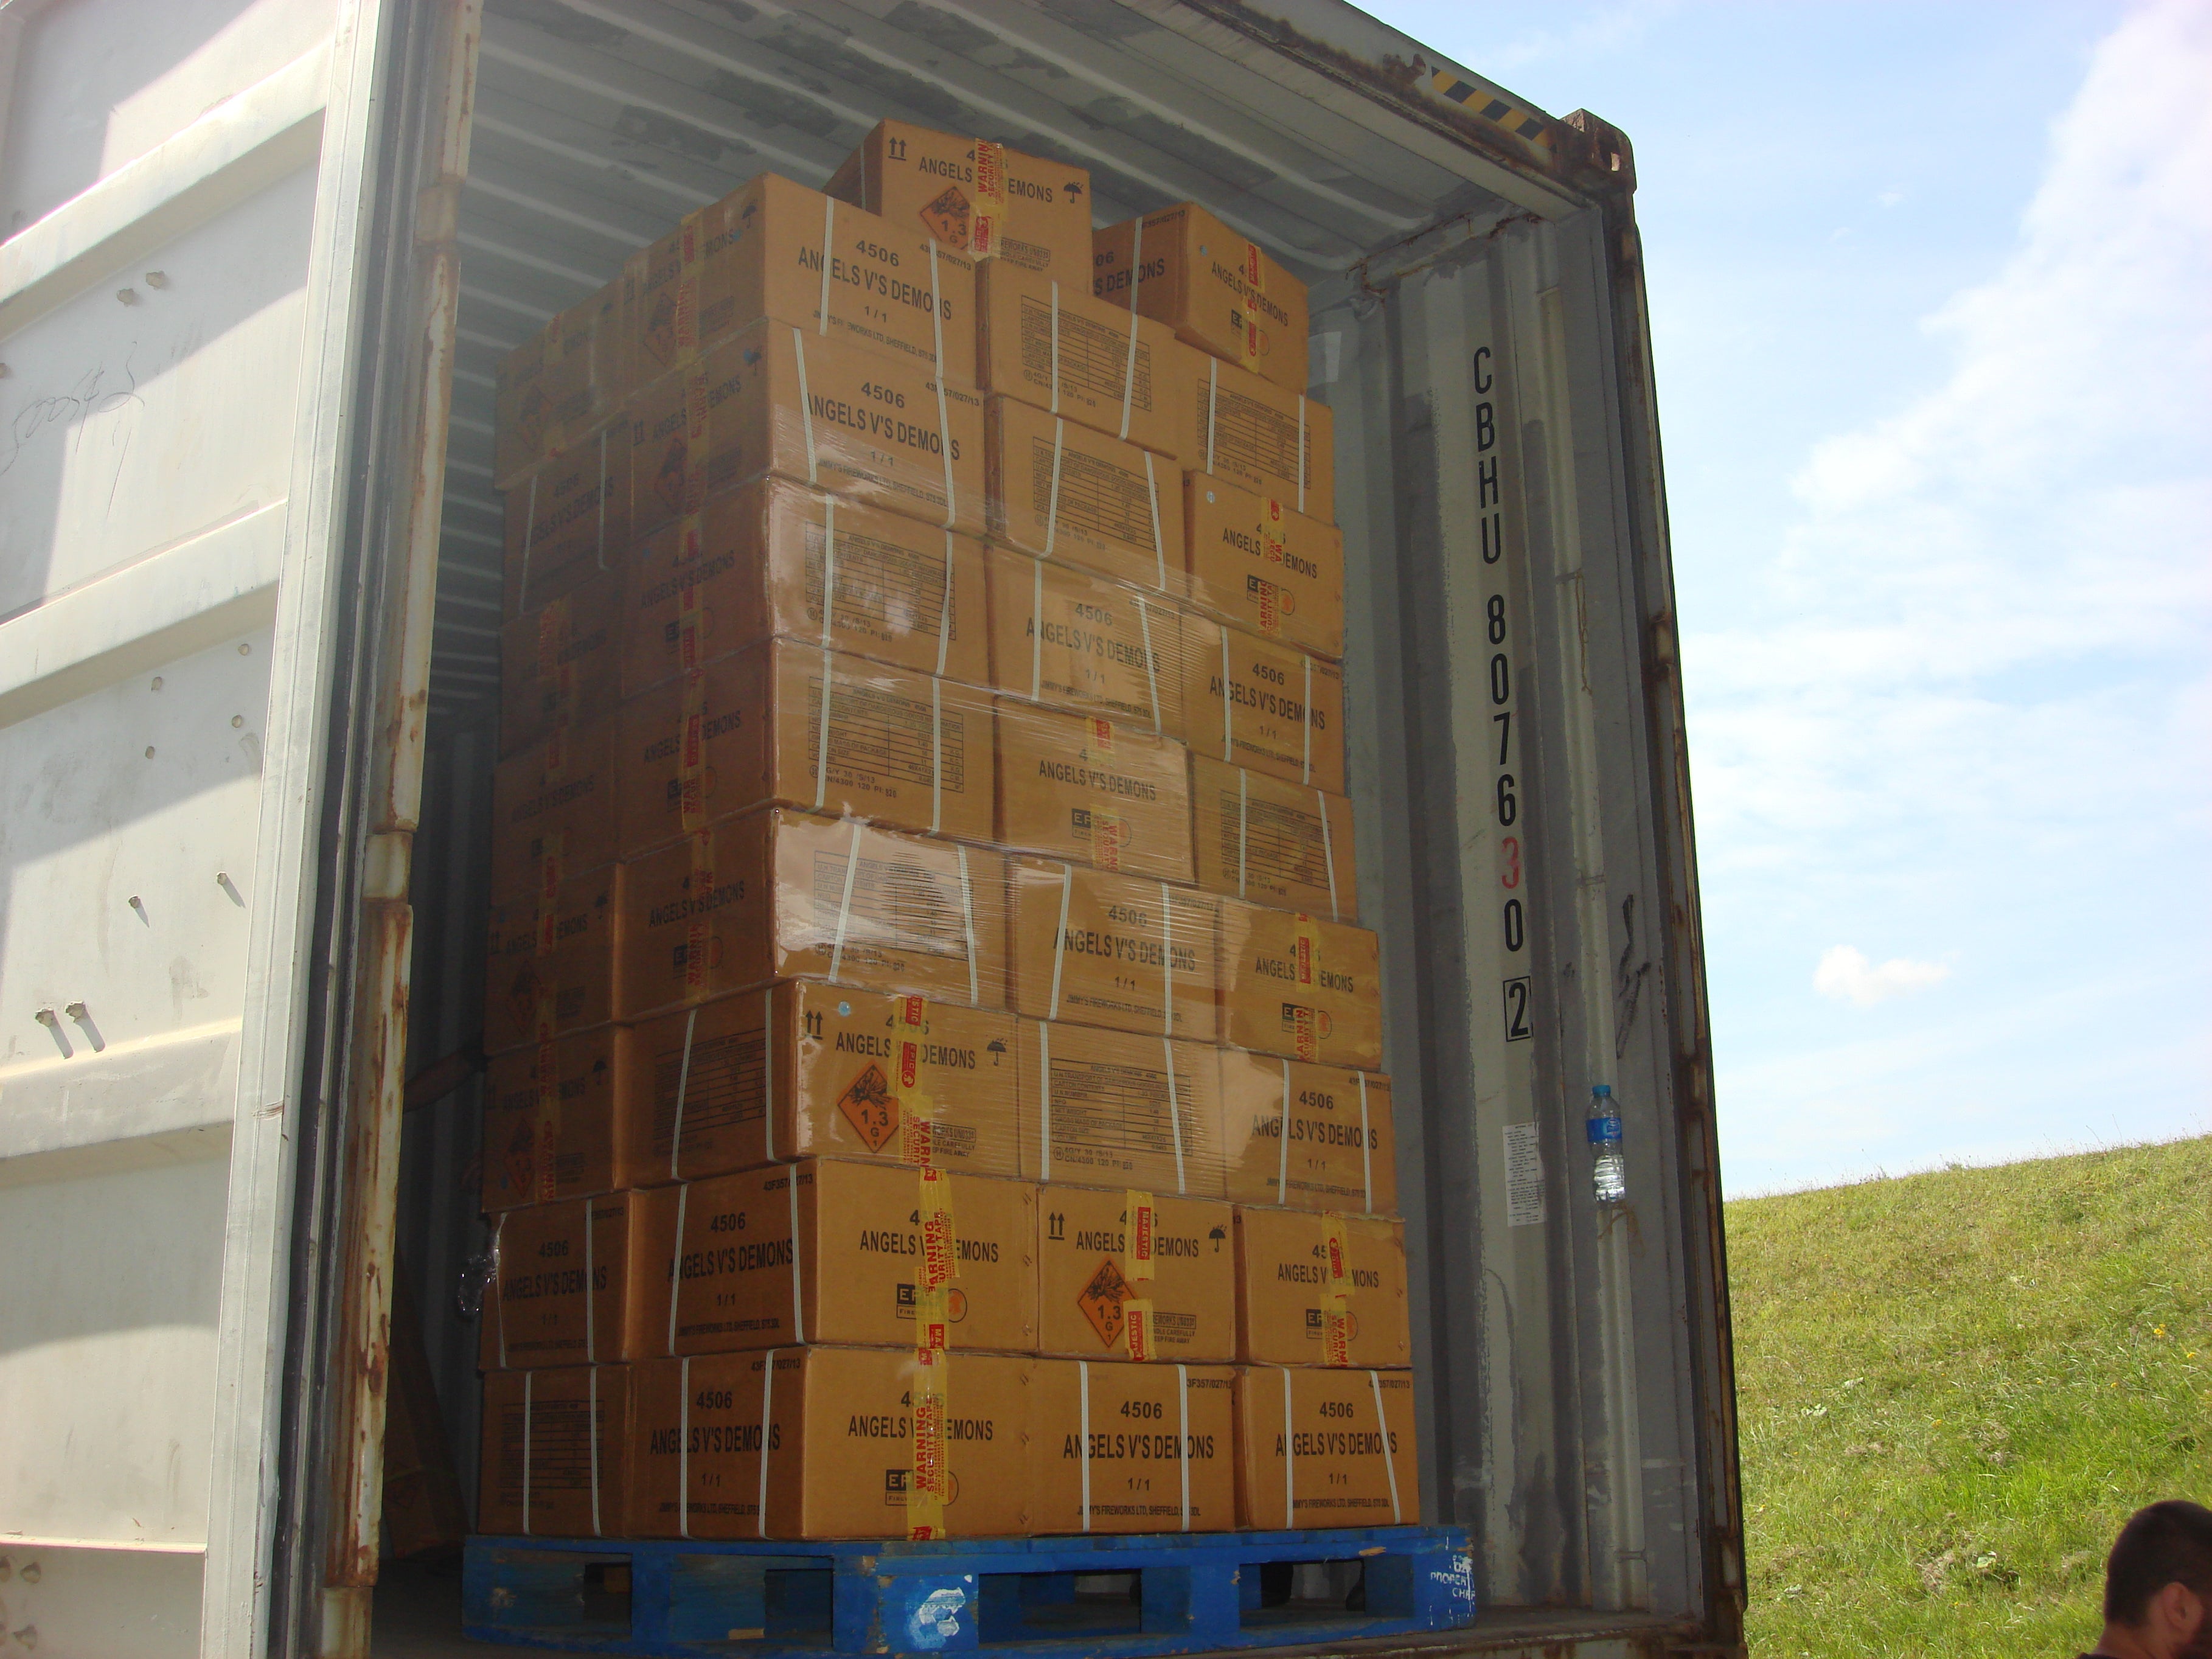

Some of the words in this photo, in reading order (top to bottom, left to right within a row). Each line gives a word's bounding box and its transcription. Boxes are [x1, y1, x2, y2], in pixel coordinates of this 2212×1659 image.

[919, 156, 972, 183] ANGELS
[1009, 178, 1052, 203] EMONS
[856, 240, 900, 267] 4506
[864, 269, 887, 296] V'S
[892, 280, 951, 321] DEMOS
[1212, 261, 1242, 297] ANGELS
[1256, 293, 1289, 327] DEMONS
[708, 374, 742, 409] EMONS
[861, 382, 905, 409] 4506
[871, 412, 893, 439] V'S
[898, 422, 960, 461] DEMOS
[1223, 527, 1261, 556] ANGELS
[1075, 603, 1113, 626] 4506
[1083, 631, 1104, 657] V'S
[1253, 663, 1285, 686] 4506
[1258, 690, 1276, 714] V'S
[1473, 347, 1501, 564] CBHU
[1487, 594, 1523, 951] 807630
[1509, 982, 1528, 1037] 2
[826, 767, 840, 776] G/Y
[1039, 760, 1086, 786] ANGELS
[1110, 775, 1156, 801] DEMONS
[858, 782, 870, 791] 120
[649, 899, 688, 928] ANGELS
[706, 880, 745, 911] DEMONS
[1108, 905, 1147, 927] 4506
[557, 913, 588, 940] EMONS
[1115, 936, 1136, 962] V'S
[1256, 957, 1295, 981] ANGELS
[1319, 970, 1354, 993] EMONS
[836, 1032, 891, 1058] ANGELS
[1299, 1091, 1334, 1110] 4506
[861, 1108, 889, 1127] 1.3
[1252, 1115, 1304, 1140] ANGLS
[1307, 1120, 1325, 1143] V'S
[870, 1127, 880, 1138] G
[920, 1121, 931, 1167] WARN
[711, 1212, 746, 1233] 4506
[1141, 1211, 1149, 1257] MAJESTIC
[538, 1240, 569, 1258] 4506
[860, 1230, 916, 1255] ANGELS
[956, 1239, 998, 1263] EMONS
[925, 1221, 938, 1285] ARNING
[1076, 1231, 1125, 1253] ANGELS
[718, 1247, 735, 1275] V'S
[739, 1238, 793, 1272] DEMONS
[1278, 1263, 1318, 1285] ANGELS
[1097, 1305, 1121, 1320] 1.3
[1105, 1321, 1113, 1332] G
[1187, 1379, 1232, 1389] 3F357/027/13
[697, 1391, 732, 1410] 4506
[1121, 1401, 1163, 1419] 4506
[1320, 1402, 1354, 1418] 4506
[703, 1427, 722, 1453] V'S
[848, 1415, 906, 1439] ANGELS
[947, 1419, 993, 1441] EMONS
[916, 1407, 927, 1489] WARNING
[1129, 1435, 1150, 1459] V'S
[1276, 1433, 1324, 1456] AGELS
[1327, 1431, 1346, 1455] V'S
[1349, 1431, 1397, 1455] DEMOS
[1102, 1505, 1135, 1516] FIREWORKS
[1149, 1506, 1179, 1517] SHEFFIELD,
